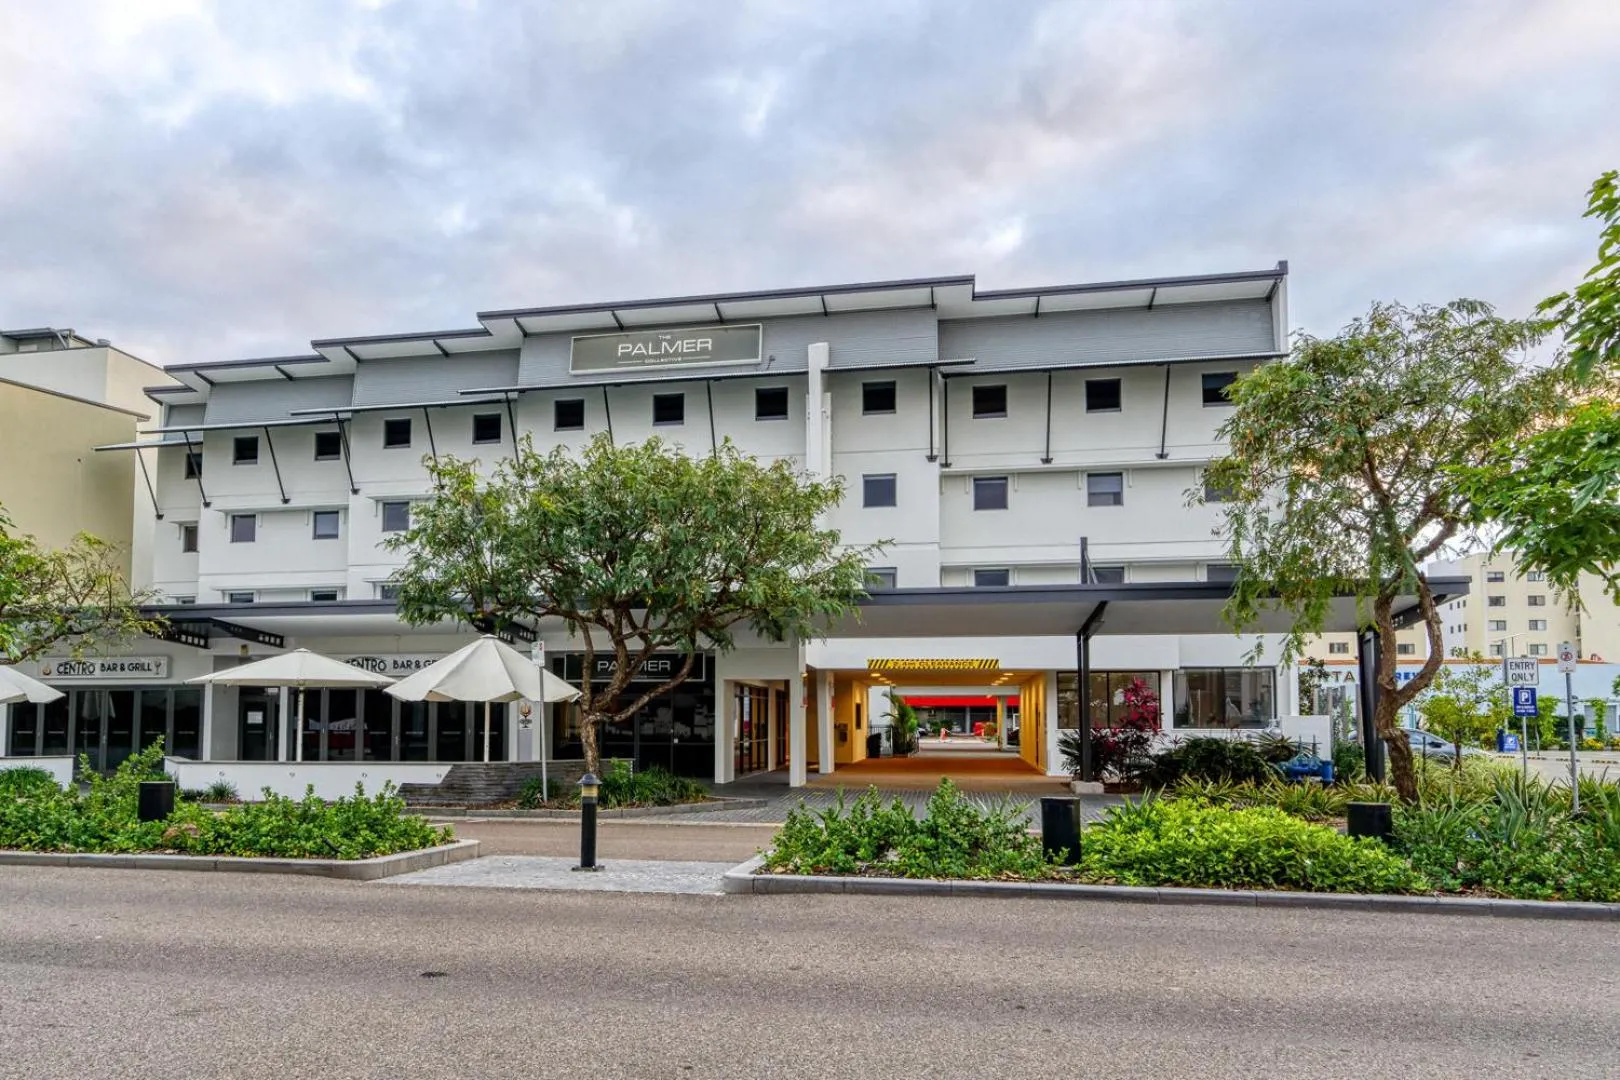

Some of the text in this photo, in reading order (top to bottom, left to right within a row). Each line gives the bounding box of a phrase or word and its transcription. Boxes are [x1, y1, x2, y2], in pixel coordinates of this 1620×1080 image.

[617, 338, 713, 357] PALMER
[57, 661, 152, 675] CENTRO BAR & GRILL
[345, 657, 387, 671] ENTRO
[393, 660, 413, 669] BAR
[414, 659, 421, 669] &
[597, 660, 671, 672] PAMER
[1509, 661, 1535, 671] ENTRY
[1511, 673, 1535, 681] ONLY
[1521, 692, 1529, 702] P
